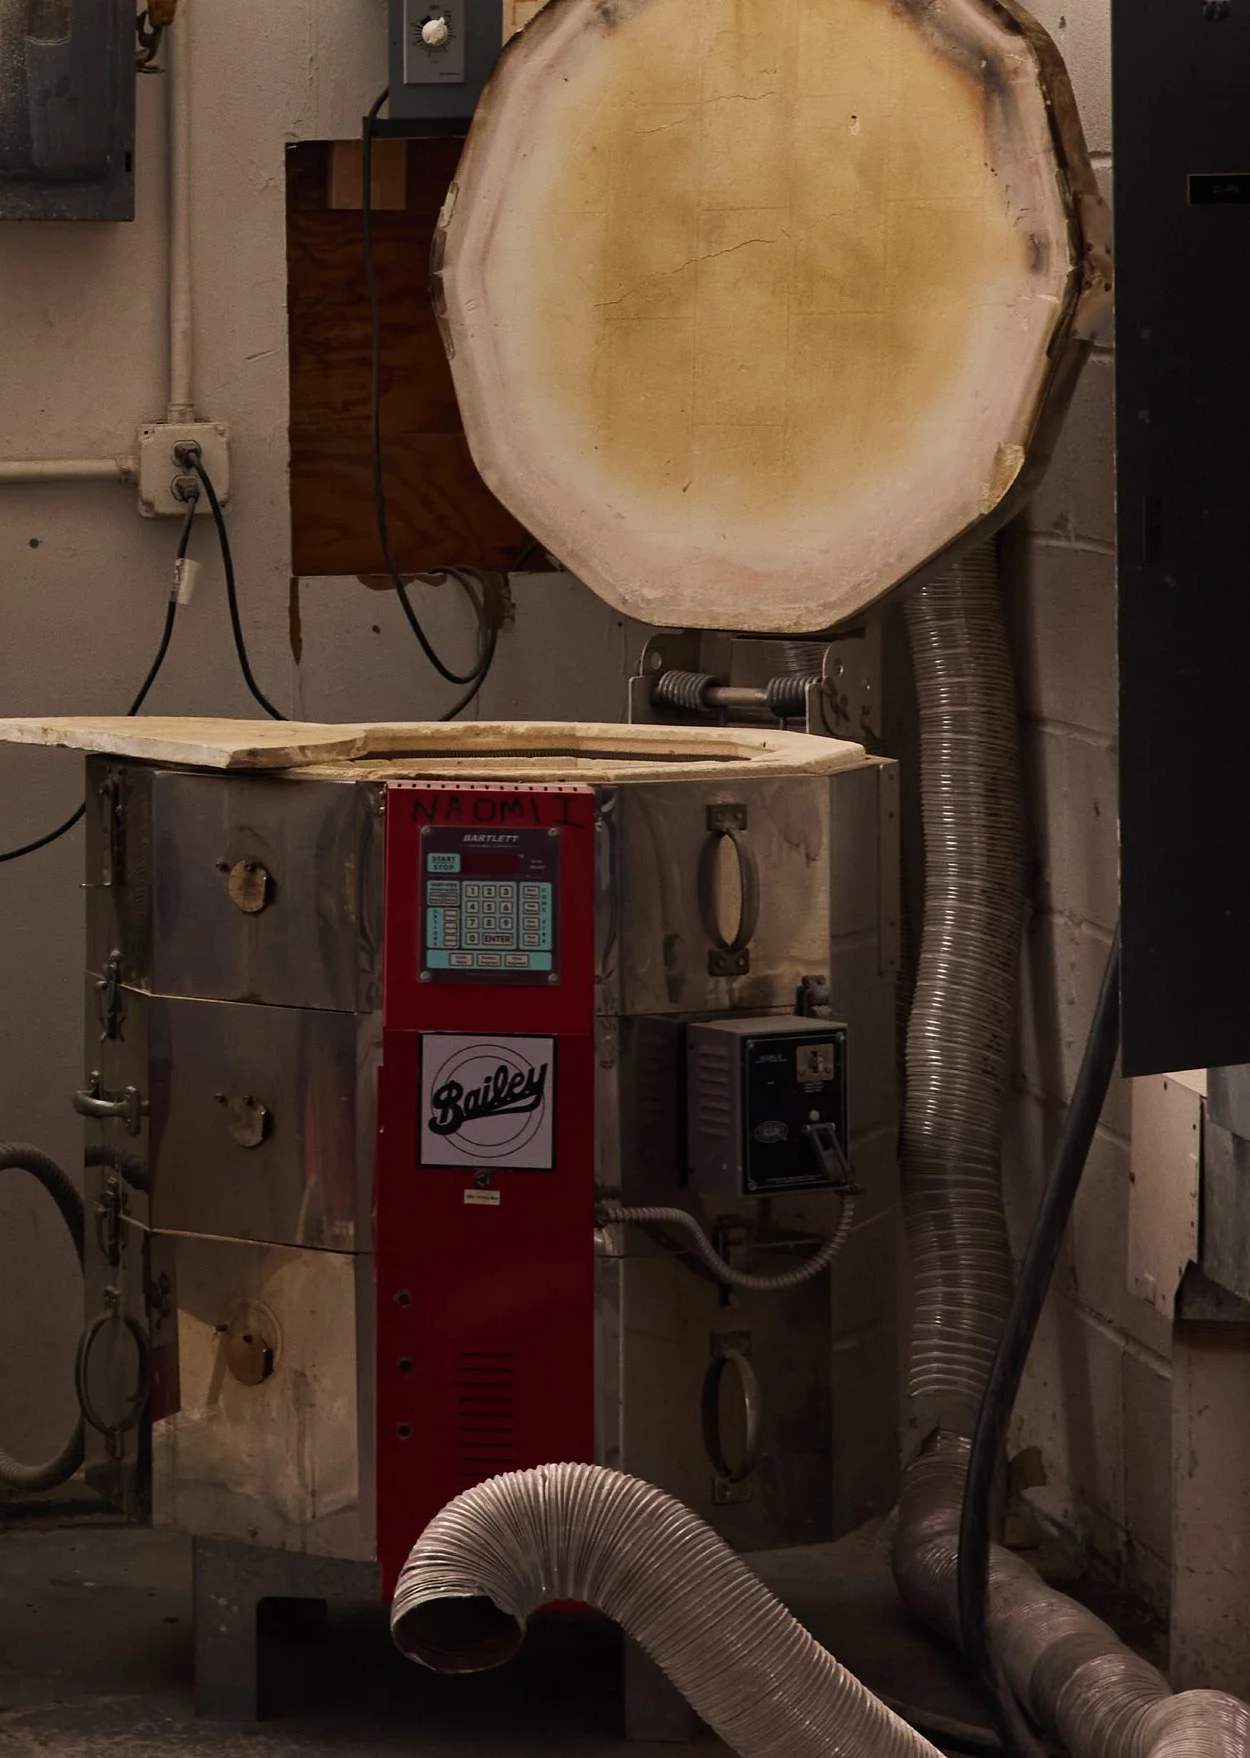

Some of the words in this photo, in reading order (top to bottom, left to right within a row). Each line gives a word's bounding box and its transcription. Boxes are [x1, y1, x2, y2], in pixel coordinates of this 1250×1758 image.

[411, 794, 542, 826] NAOMI
[461, 834, 522, 844] BARTLETT
[431, 855, 456, 863] START
[483, 935, 512, 944] ENTER
[428, 1063, 548, 1136] Bailey
